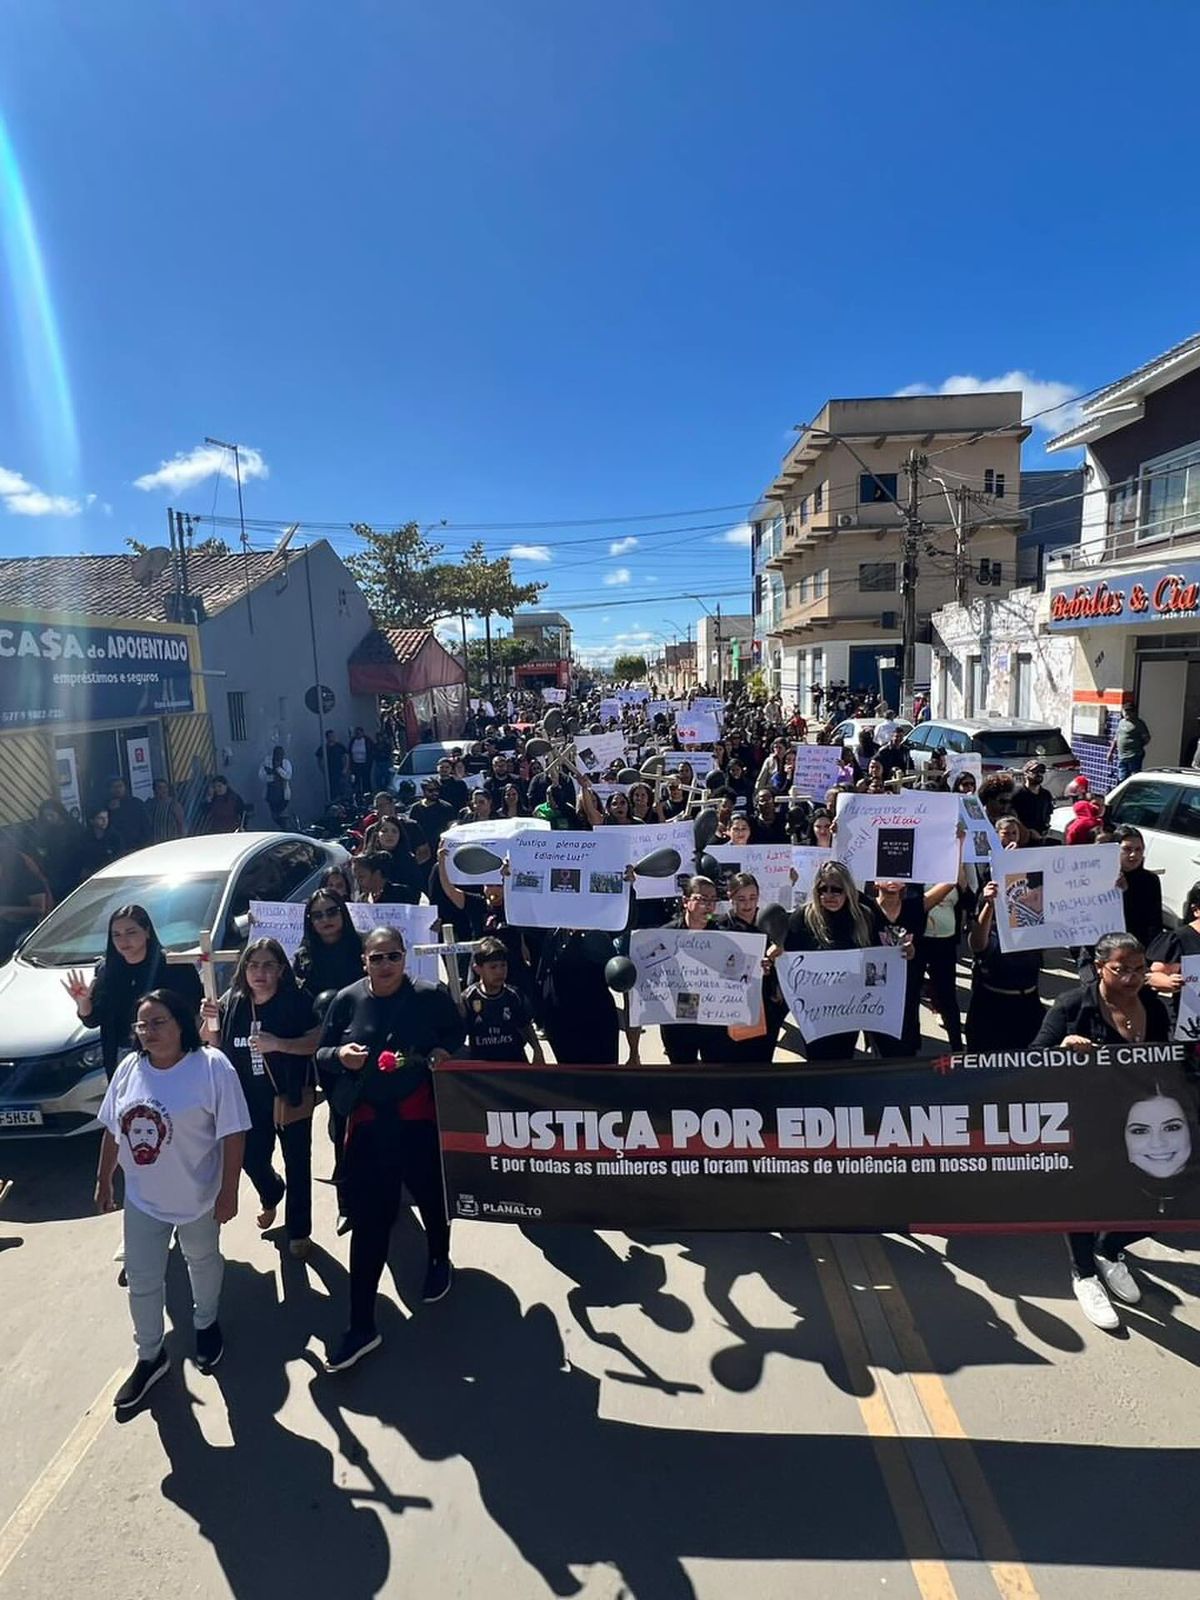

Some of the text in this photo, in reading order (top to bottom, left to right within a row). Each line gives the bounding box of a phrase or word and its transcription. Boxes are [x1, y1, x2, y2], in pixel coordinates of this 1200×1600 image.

[1052, 574, 1199, 621] Bebidas & Cia
[87, 644, 105, 659] do
[107, 635, 188, 662] APOSENTADO
[53, 671, 159, 687] empréstimos e seguros
[581, 841, 596, 849] por
[1097, 1047, 1111, 1066] É
[1117, 1045, 1185, 1066] CRIME
[485, 1102, 1070, 1158] JUSTIÇA POR EDILANE LUZ
[490, 1152, 1074, 1176] E por todas as mulheres que foram vítimas de violência em nosso município.
[482, 1203, 542, 1216] PLANALTO
